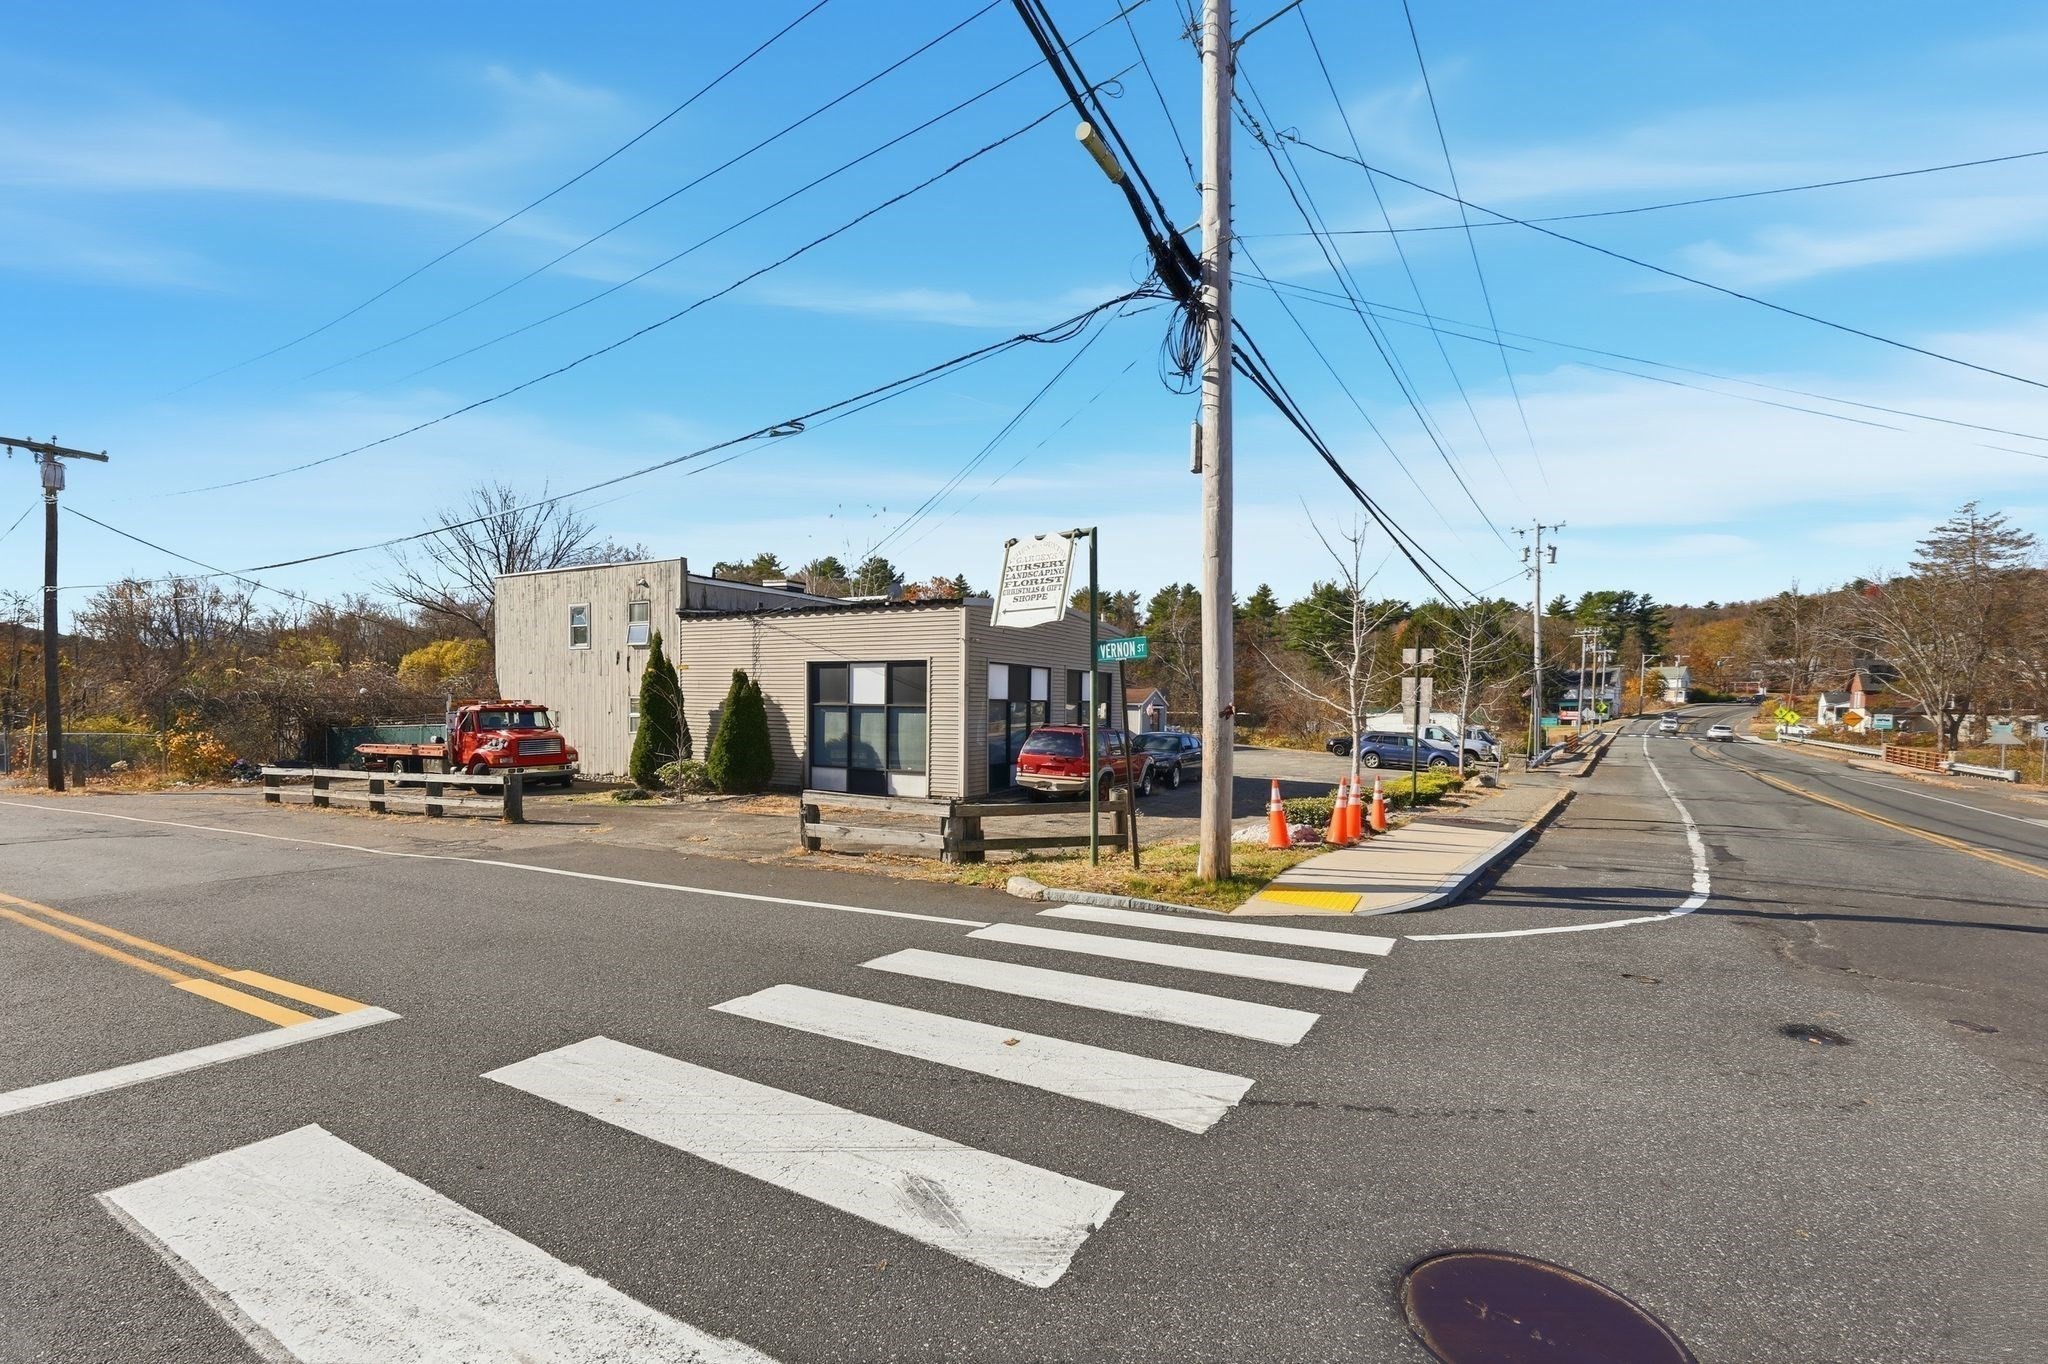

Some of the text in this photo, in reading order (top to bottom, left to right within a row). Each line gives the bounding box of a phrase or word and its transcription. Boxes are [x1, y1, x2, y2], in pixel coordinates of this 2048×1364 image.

[1006, 559, 1066, 573] NURSERY
[1005, 568, 1065, 580] LANDSCAPING
[1004, 576, 1064, 588] FLORIST
[1003, 586, 1040, 596] CHRISTMAS
[1046, 583, 1063, 592] GIFT
[1012, 593, 1048, 603] SHOPPE
[1100, 641, 1145, 659] VERNON ST
